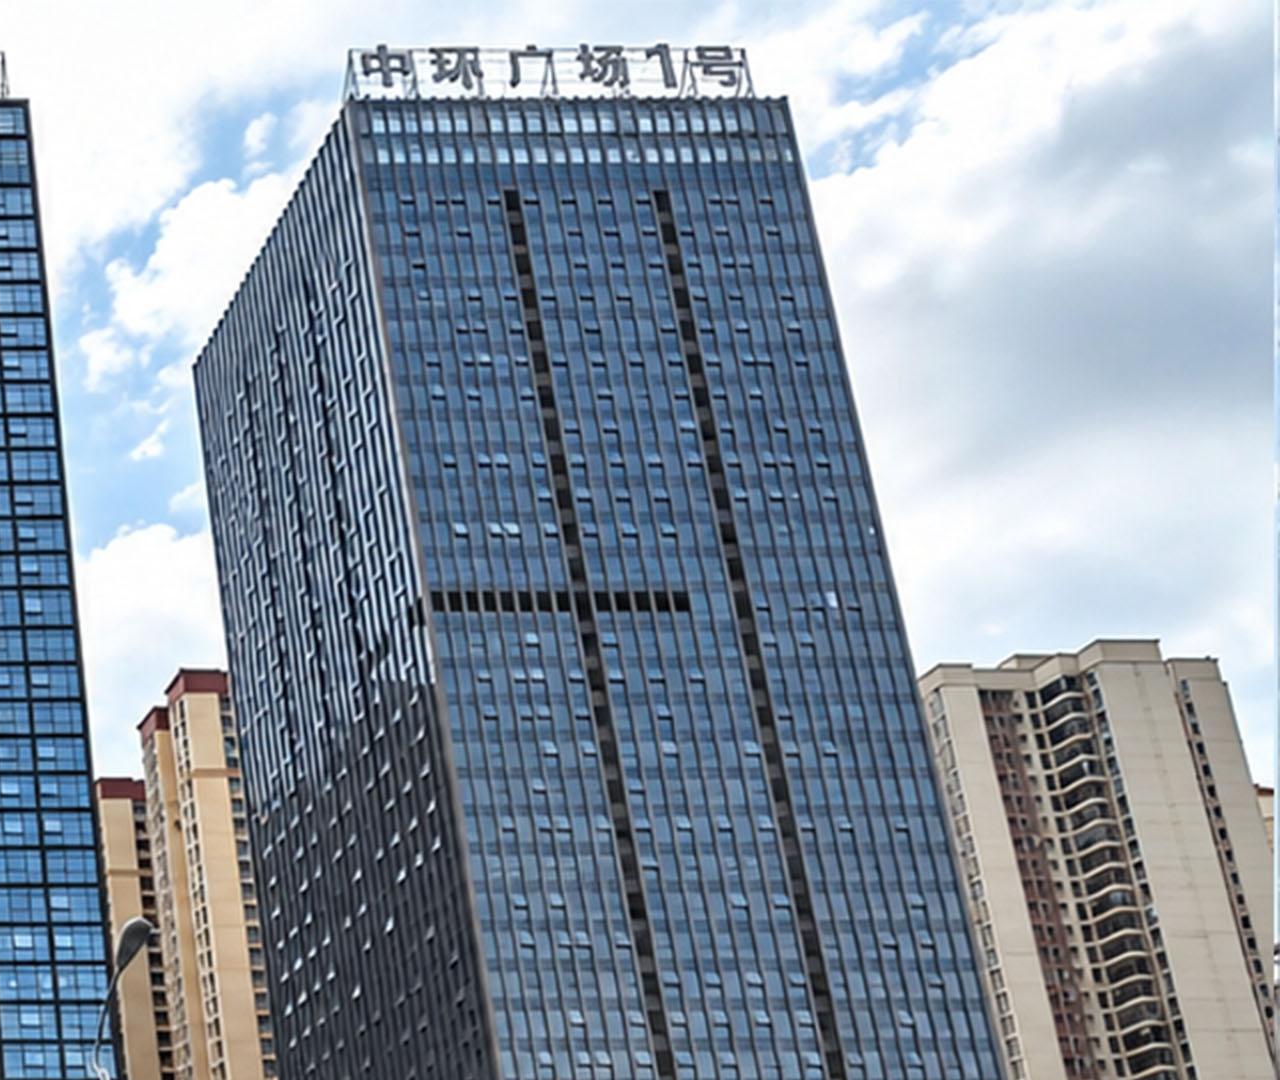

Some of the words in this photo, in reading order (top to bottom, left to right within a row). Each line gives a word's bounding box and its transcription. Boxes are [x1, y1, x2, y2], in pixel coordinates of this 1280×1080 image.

[361, 44, 745, 88] 中环广场1号
